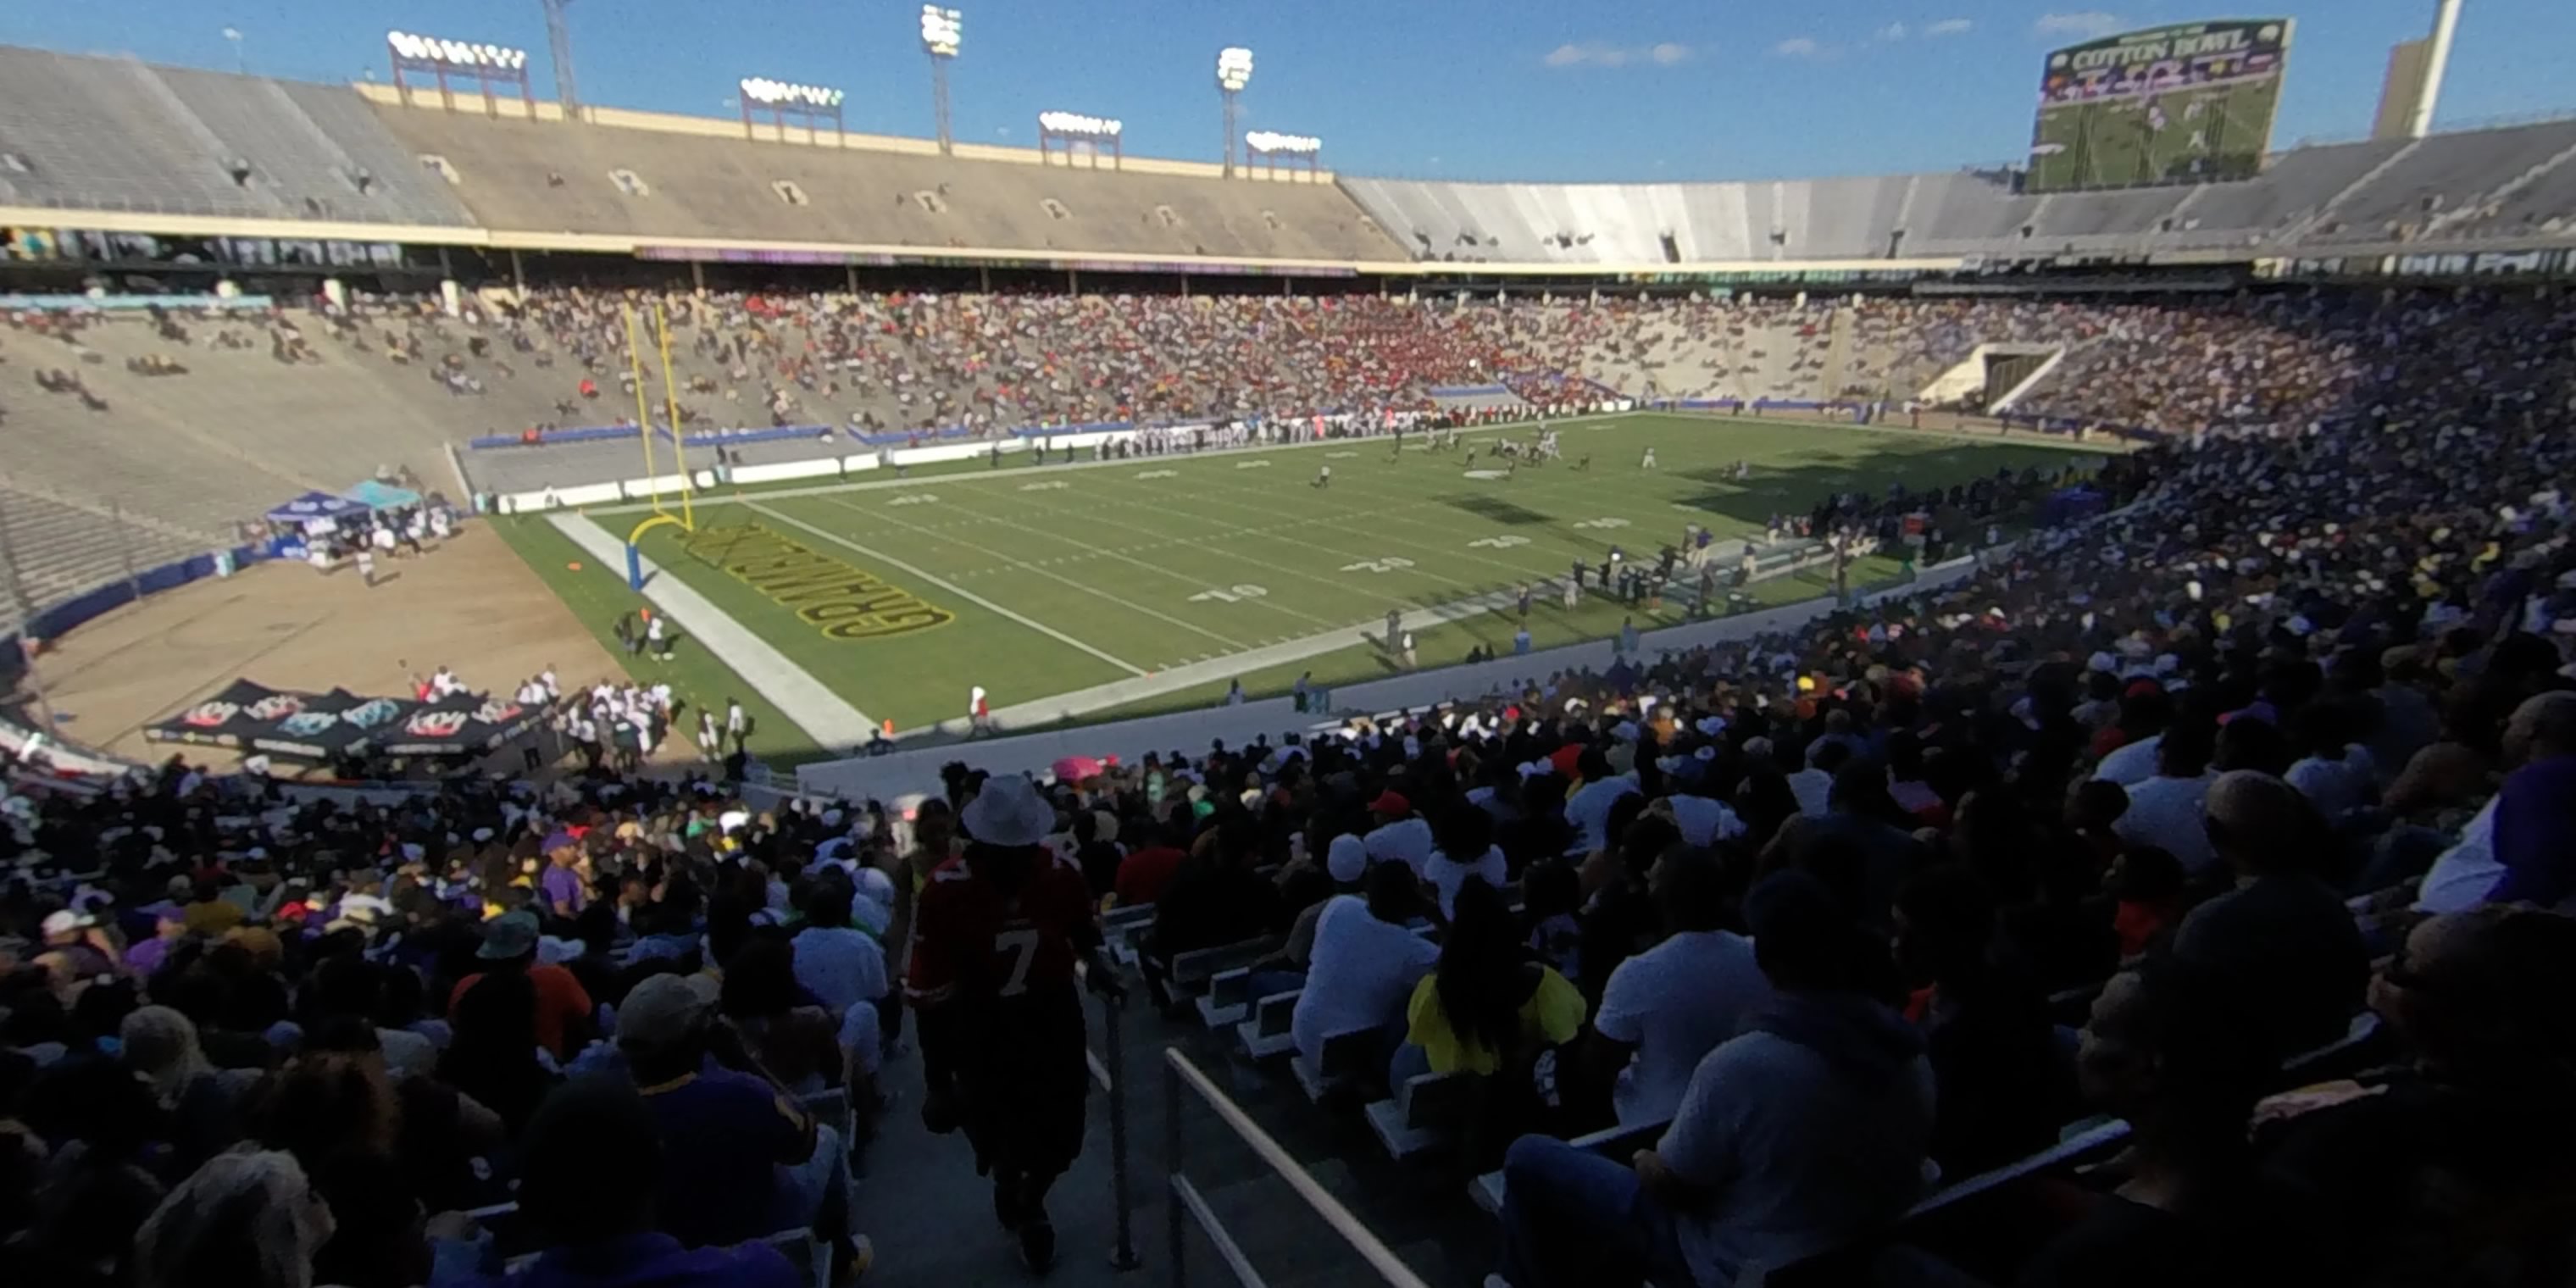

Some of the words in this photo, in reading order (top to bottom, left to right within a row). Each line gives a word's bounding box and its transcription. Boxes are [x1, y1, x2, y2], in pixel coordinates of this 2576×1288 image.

[2073, 42, 2169, 70] COTTON
[2174, 29, 2251, 57] BOWL
[995, 929, 1041, 997] 7
